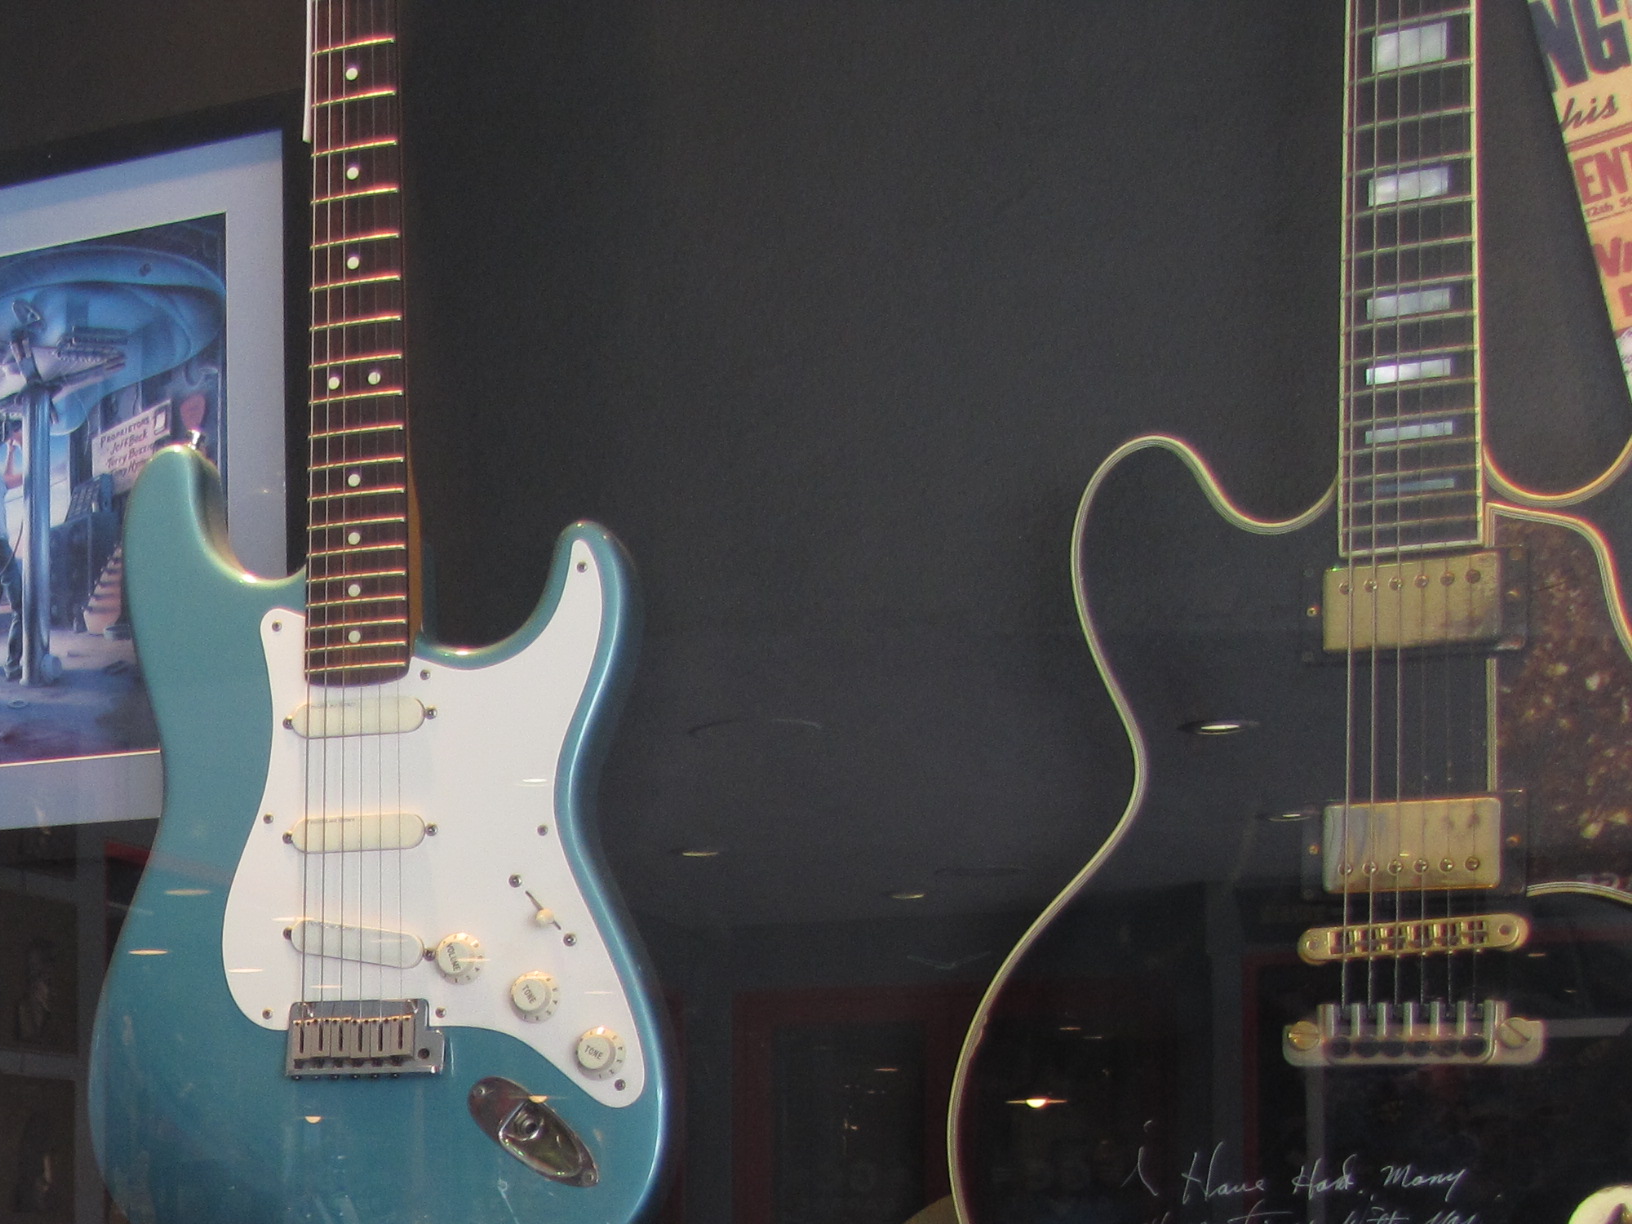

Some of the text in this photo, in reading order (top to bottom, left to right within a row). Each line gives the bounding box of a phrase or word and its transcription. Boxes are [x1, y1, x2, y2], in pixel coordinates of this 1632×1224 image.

[445, 942, 461, 972] VOLUME
[522, 984, 537, 1004] TONE
[583, 1044, 604, 1060] TONE
[1381, 1164, 1467, 1202] Many
